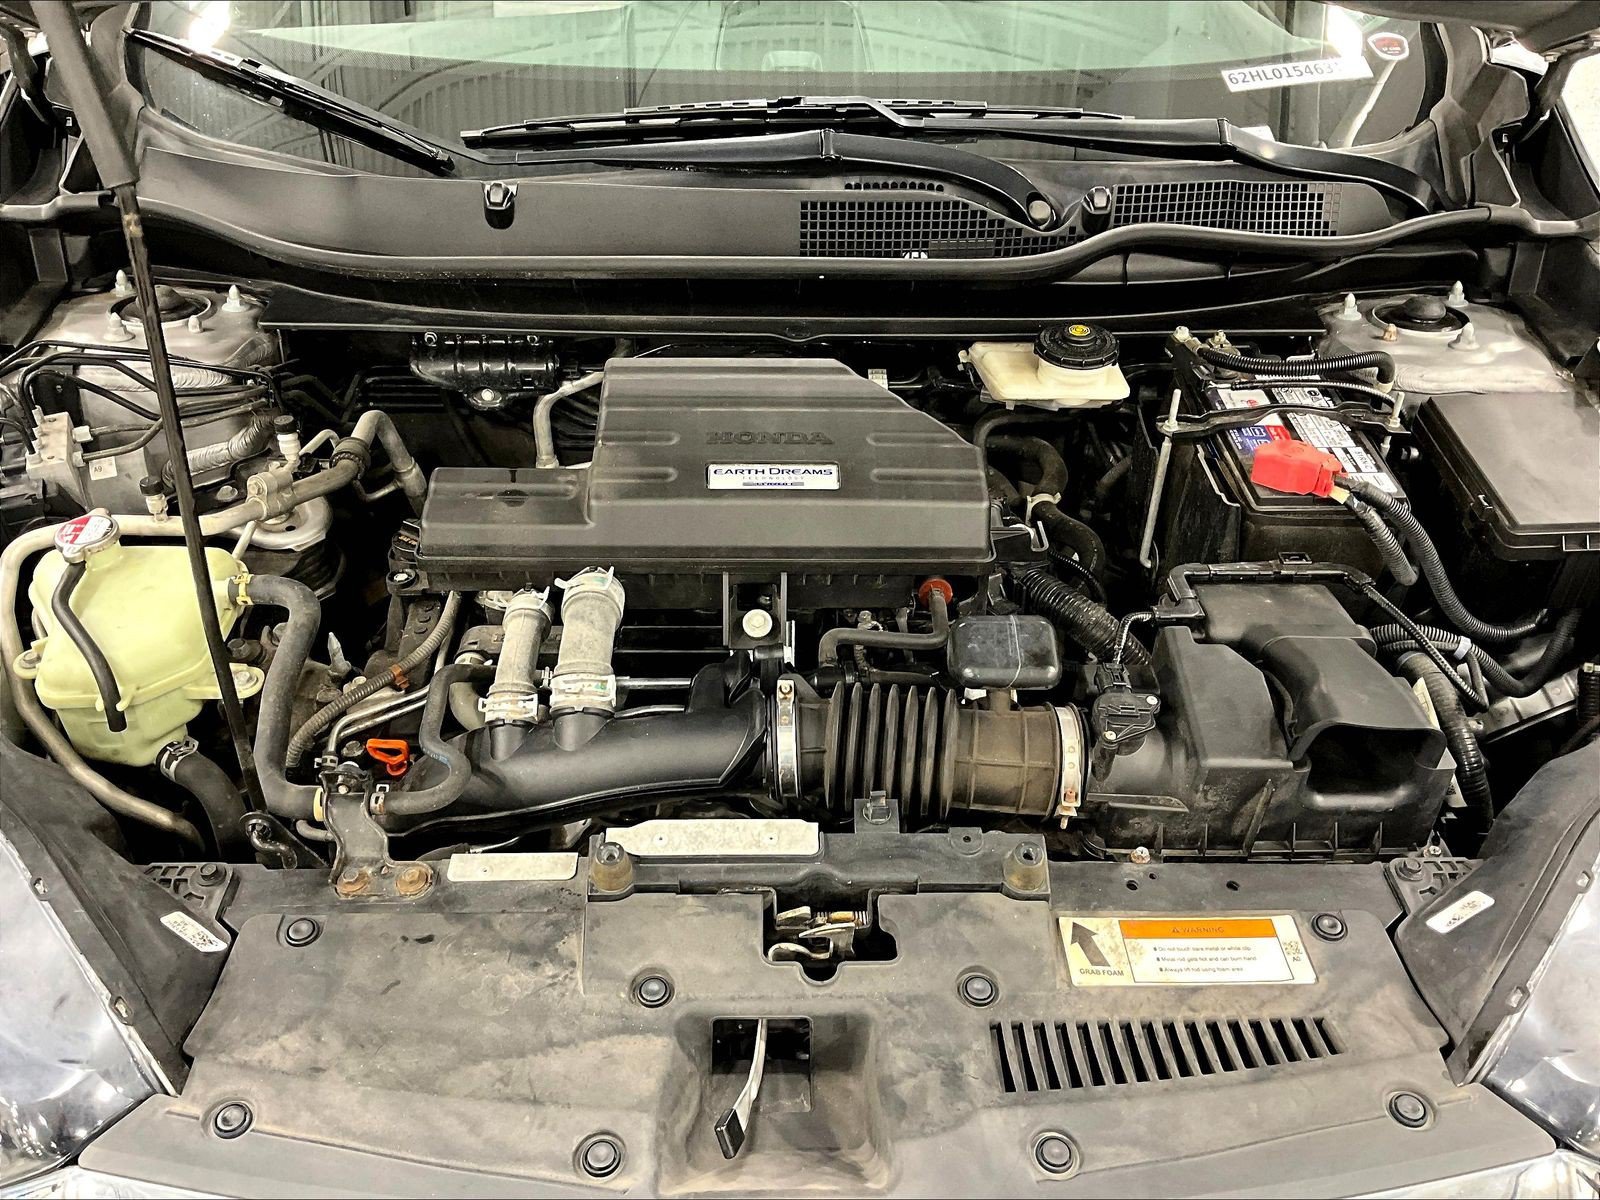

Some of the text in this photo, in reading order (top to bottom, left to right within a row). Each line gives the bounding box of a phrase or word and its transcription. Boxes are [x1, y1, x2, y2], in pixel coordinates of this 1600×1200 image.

[705, 431, 835, 446] HONDA
[713, 467, 833, 476] EARTH DREAMS
[1182, 926, 1225, 934] WARNING
[1079, 968, 1125, 977] GRAB FOAM
